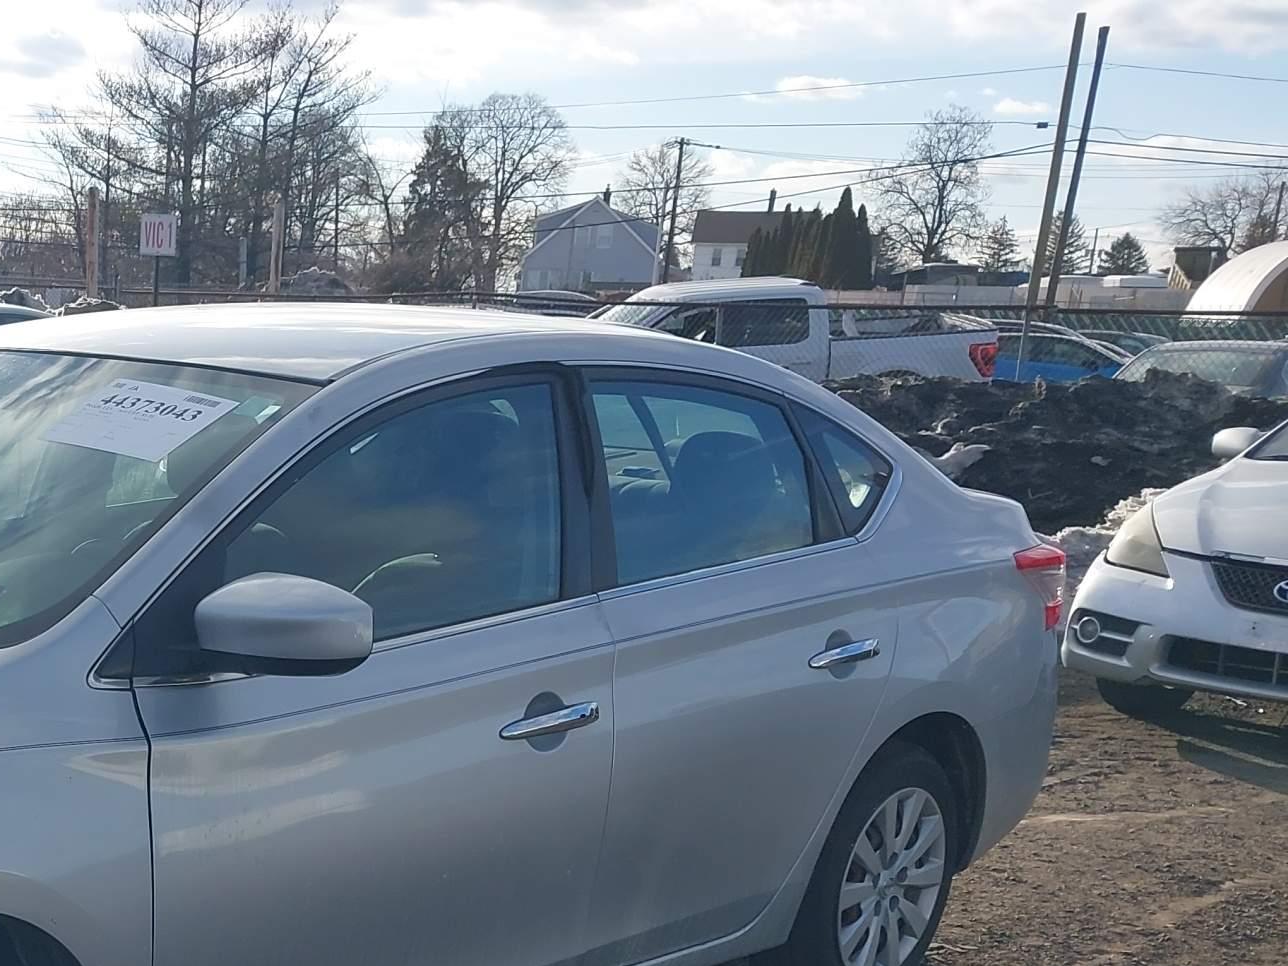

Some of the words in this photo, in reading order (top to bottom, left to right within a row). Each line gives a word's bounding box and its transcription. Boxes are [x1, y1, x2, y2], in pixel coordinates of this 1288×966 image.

[144, 221, 164, 249] VIC
[168, 222, 172, 249] 1
[100, 393, 203, 422] 44373043
